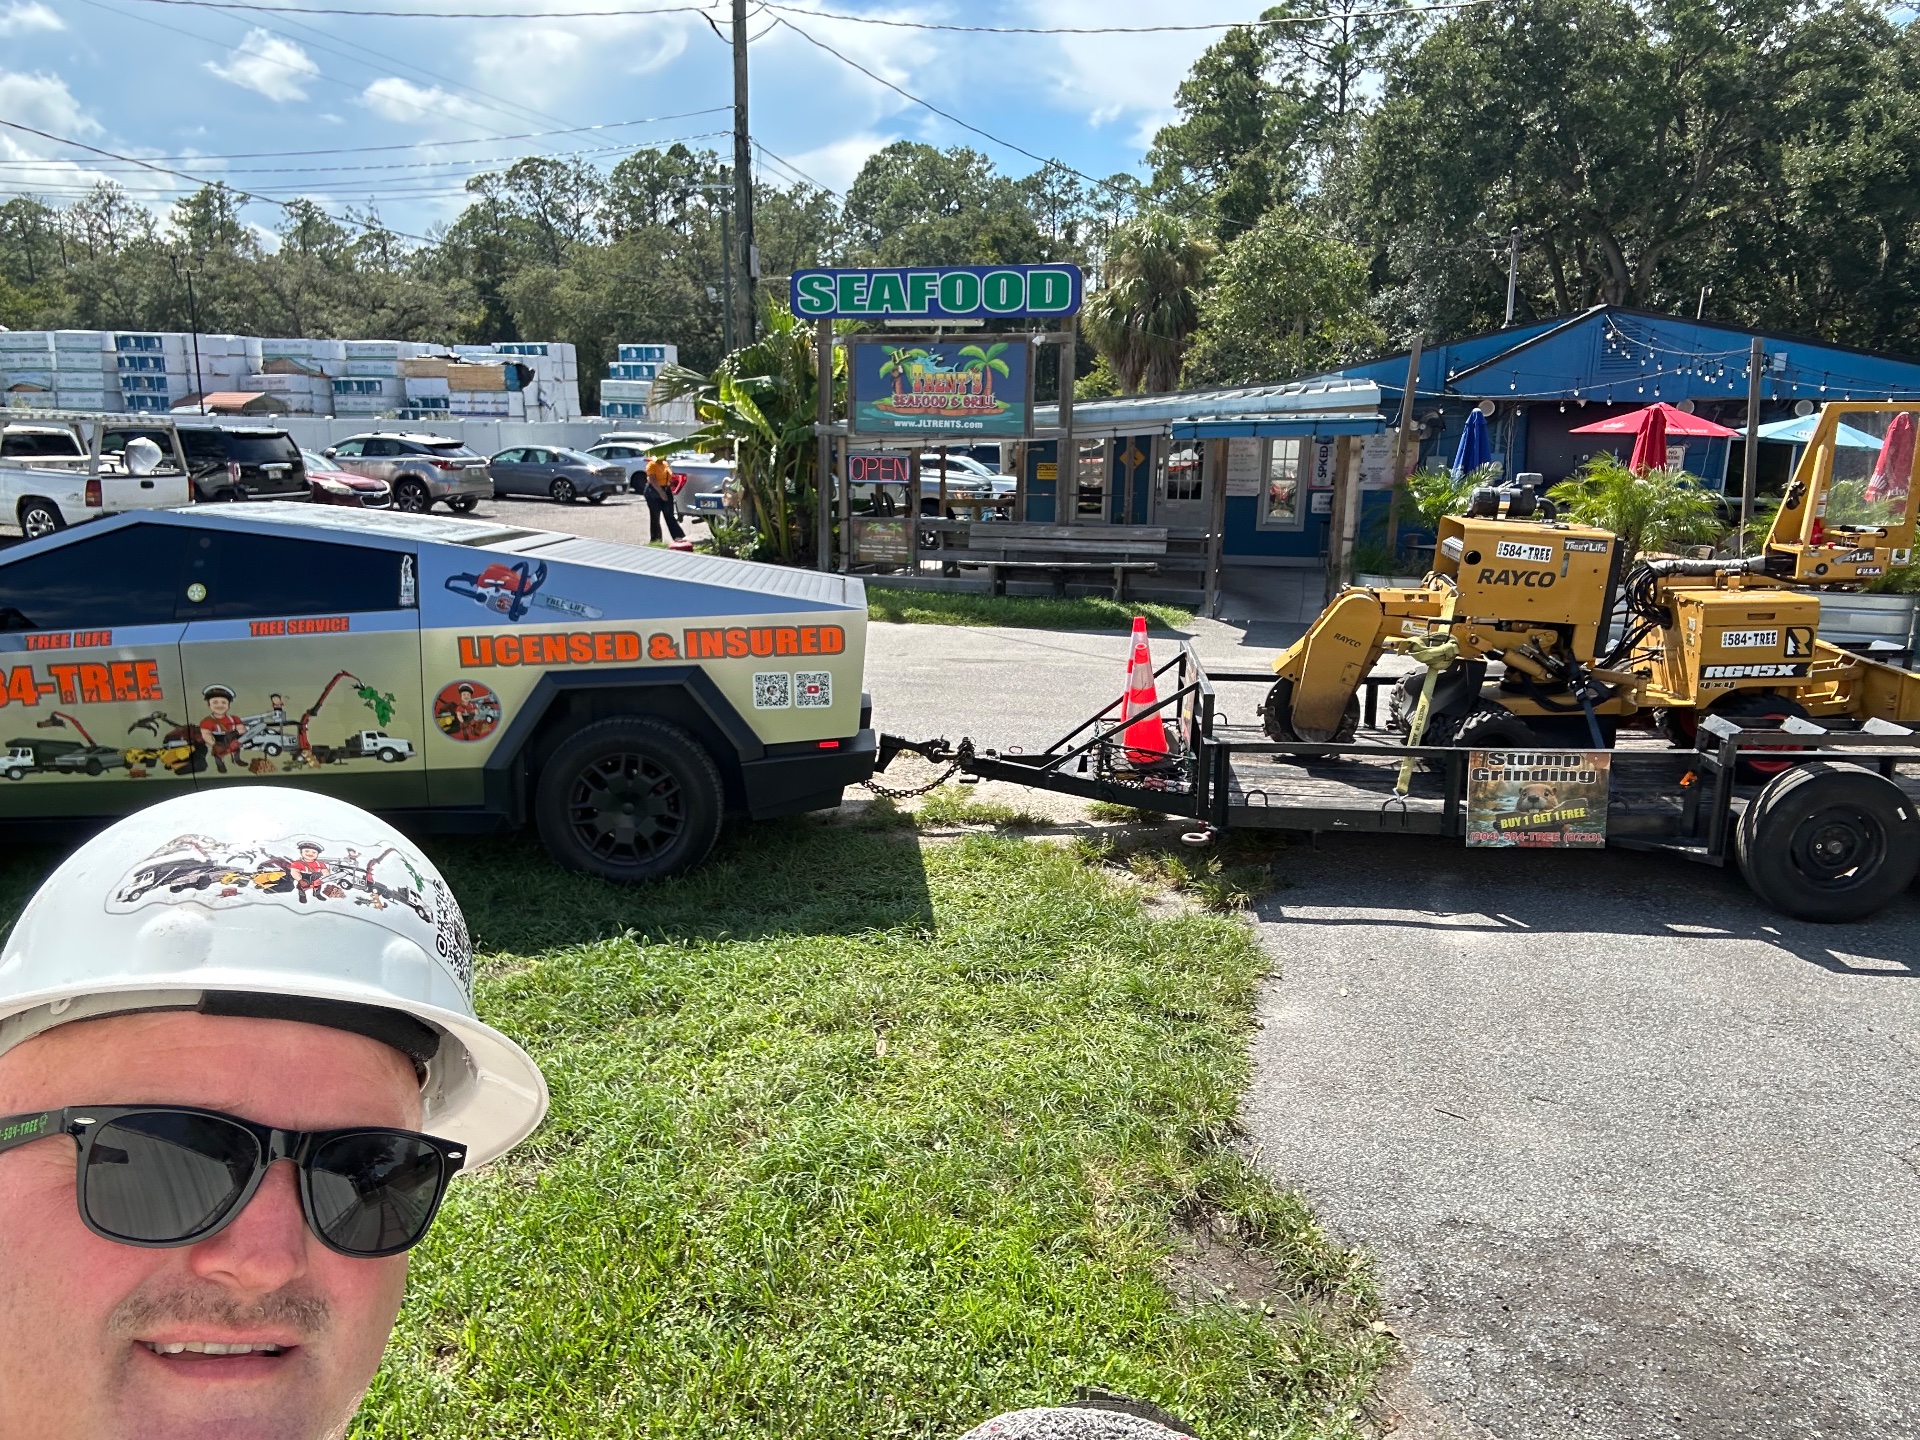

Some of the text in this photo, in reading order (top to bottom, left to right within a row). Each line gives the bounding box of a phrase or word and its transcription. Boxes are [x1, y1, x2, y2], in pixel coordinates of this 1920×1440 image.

[797, 270, 1072, 314] SEAFOOD
[890, 347, 911, 364] JL
[911, 364, 983, 394] TRENT'S
[892, 394, 998, 409] SEAFOOD & GRILL
[894, 420, 983, 429] www.JLTRENTS.com
[851, 457, 908, 481] OPEN
[1503, 544, 1551, 561] 584-TREE
[1477, 568, 1556, 588] RAYCO
[249, 616, 349, 637] TREE SERVICE
[25, 630, 112, 651] TREE LIFE
[458, 625, 845, 668] LICENSED & INSURED
[1333, 632, 1362, 648] RAYCO
[1727, 631, 1777, 646] 584-TREE
[1703, 664, 1798, 678] RG45X
[1487, 752, 1582, 768] Stump
[1471, 767, 1597, 784] Grinding
[1501, 807, 1587, 829] BUY 1 GET 1 FREE
[1469, 832, 1500, 842] (904)
[1503, 831, 1561, 842] 584-TREE
